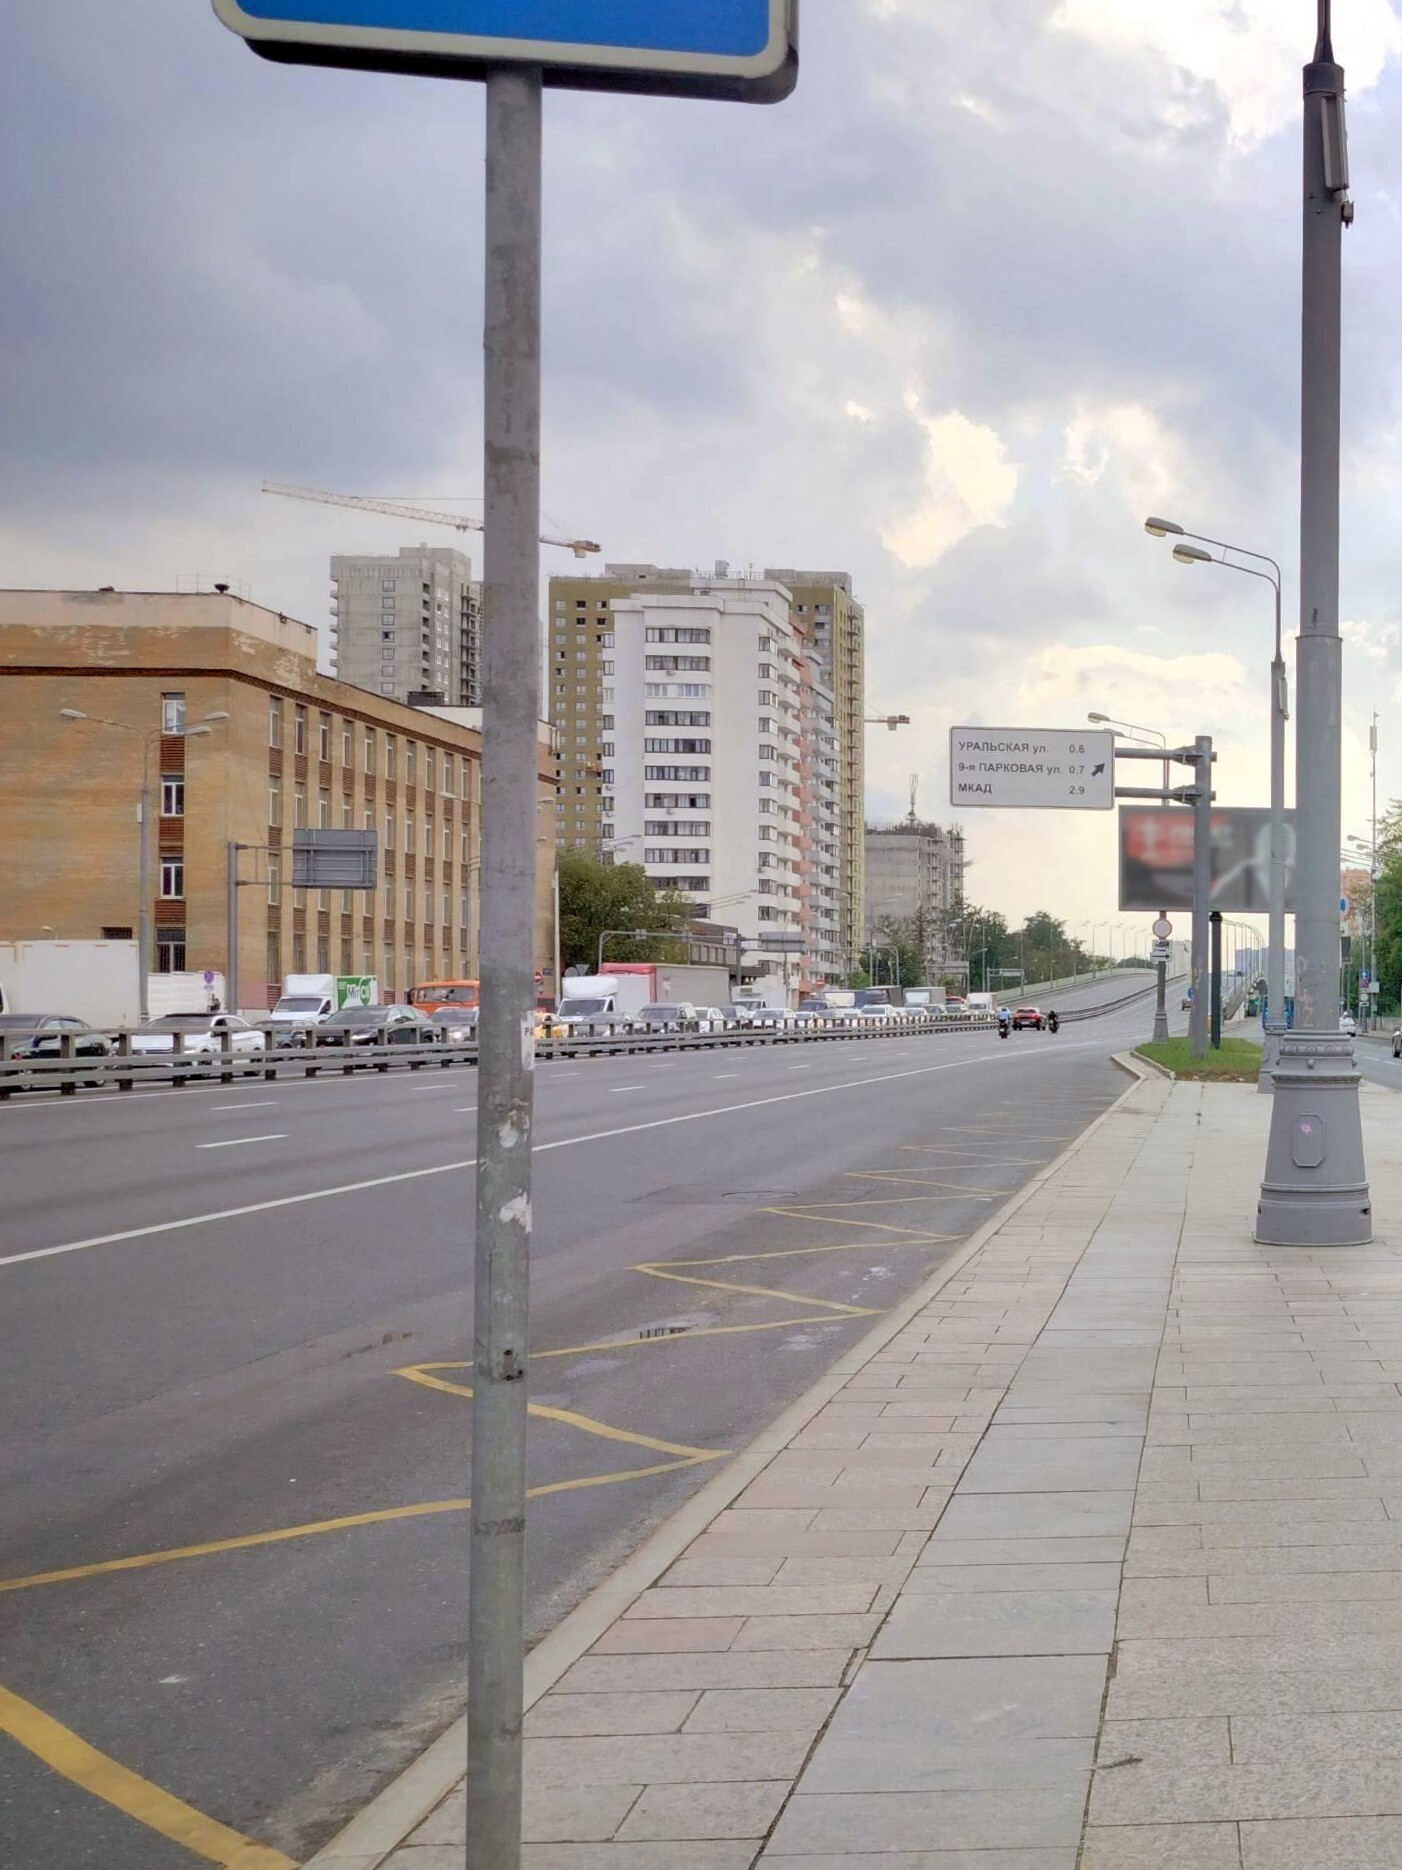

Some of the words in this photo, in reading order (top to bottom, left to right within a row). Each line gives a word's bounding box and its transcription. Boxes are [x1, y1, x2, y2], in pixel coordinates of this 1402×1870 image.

[958, 741, 1029, 753] УРАЛЬСКАЯ
[1032, 744, 1049, 755] ул.
[958, 762, 975, 772] 9-я
[979, 762, 1043, 774] ПАРКОВАЯ
[1046, 765, 1063, 776] ул.
[958, 783, 992, 795] МКАД
[1068, 785, 1085, 795] 2.9
